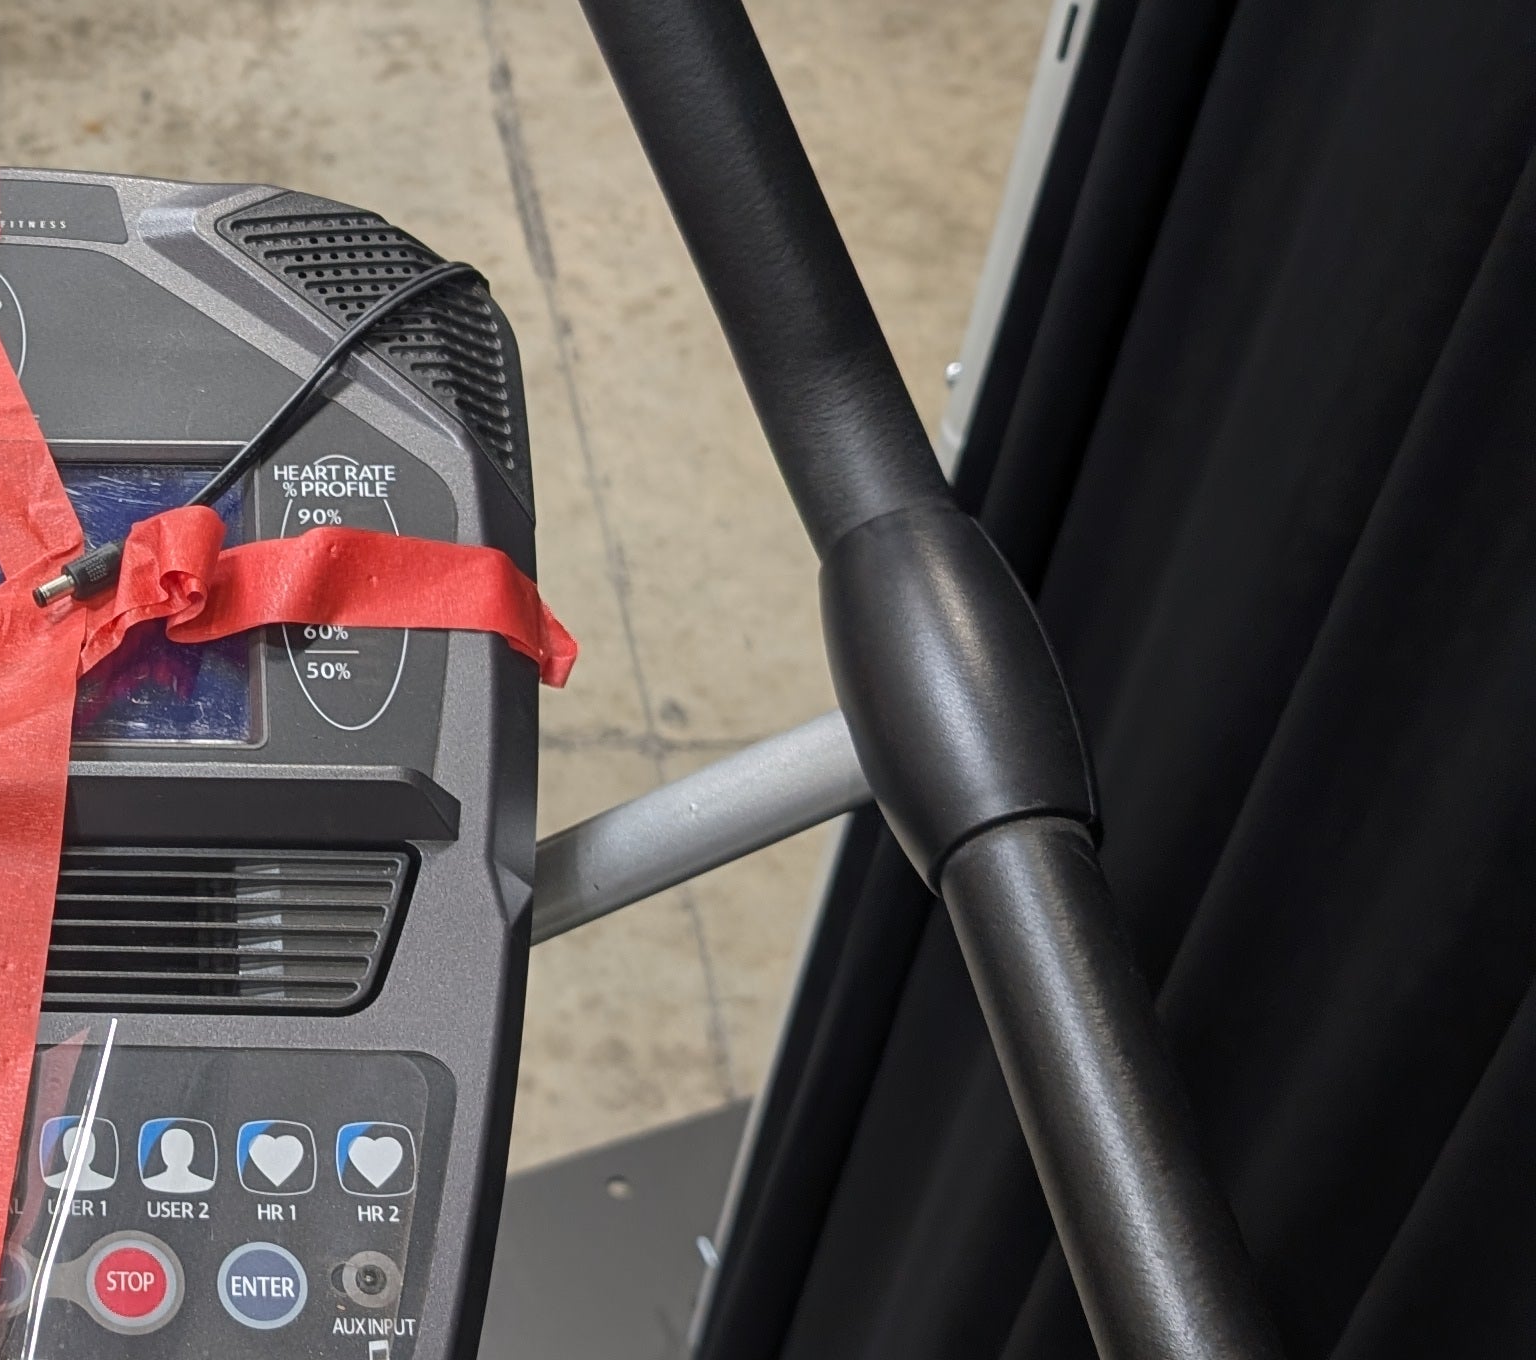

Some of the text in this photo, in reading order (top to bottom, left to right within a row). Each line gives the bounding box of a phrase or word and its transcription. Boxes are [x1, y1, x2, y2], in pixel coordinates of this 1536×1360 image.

[0, 219, 67, 230] FITNESS
[273, 464, 397, 482] HEART RATE
[282, 480, 389, 498] % PROFILE
[297, 507, 343, 525] 90%
[303, 623, 349, 641] 60%
[306, 661, 352, 680] 50%
[47, 1198, 95, 1217] UER
[99, 1199, 108, 1217] 1
[147, 1200, 210, 1219] USER 2
[257, 1203, 297, 1221] HR 1
[357, 1204, 401, 1223] HR 2
[106, 1270, 156, 1292] STOP
[230, 1275, 296, 1298] ENTER
[332, 1316, 417, 1337] AUX INPUT
